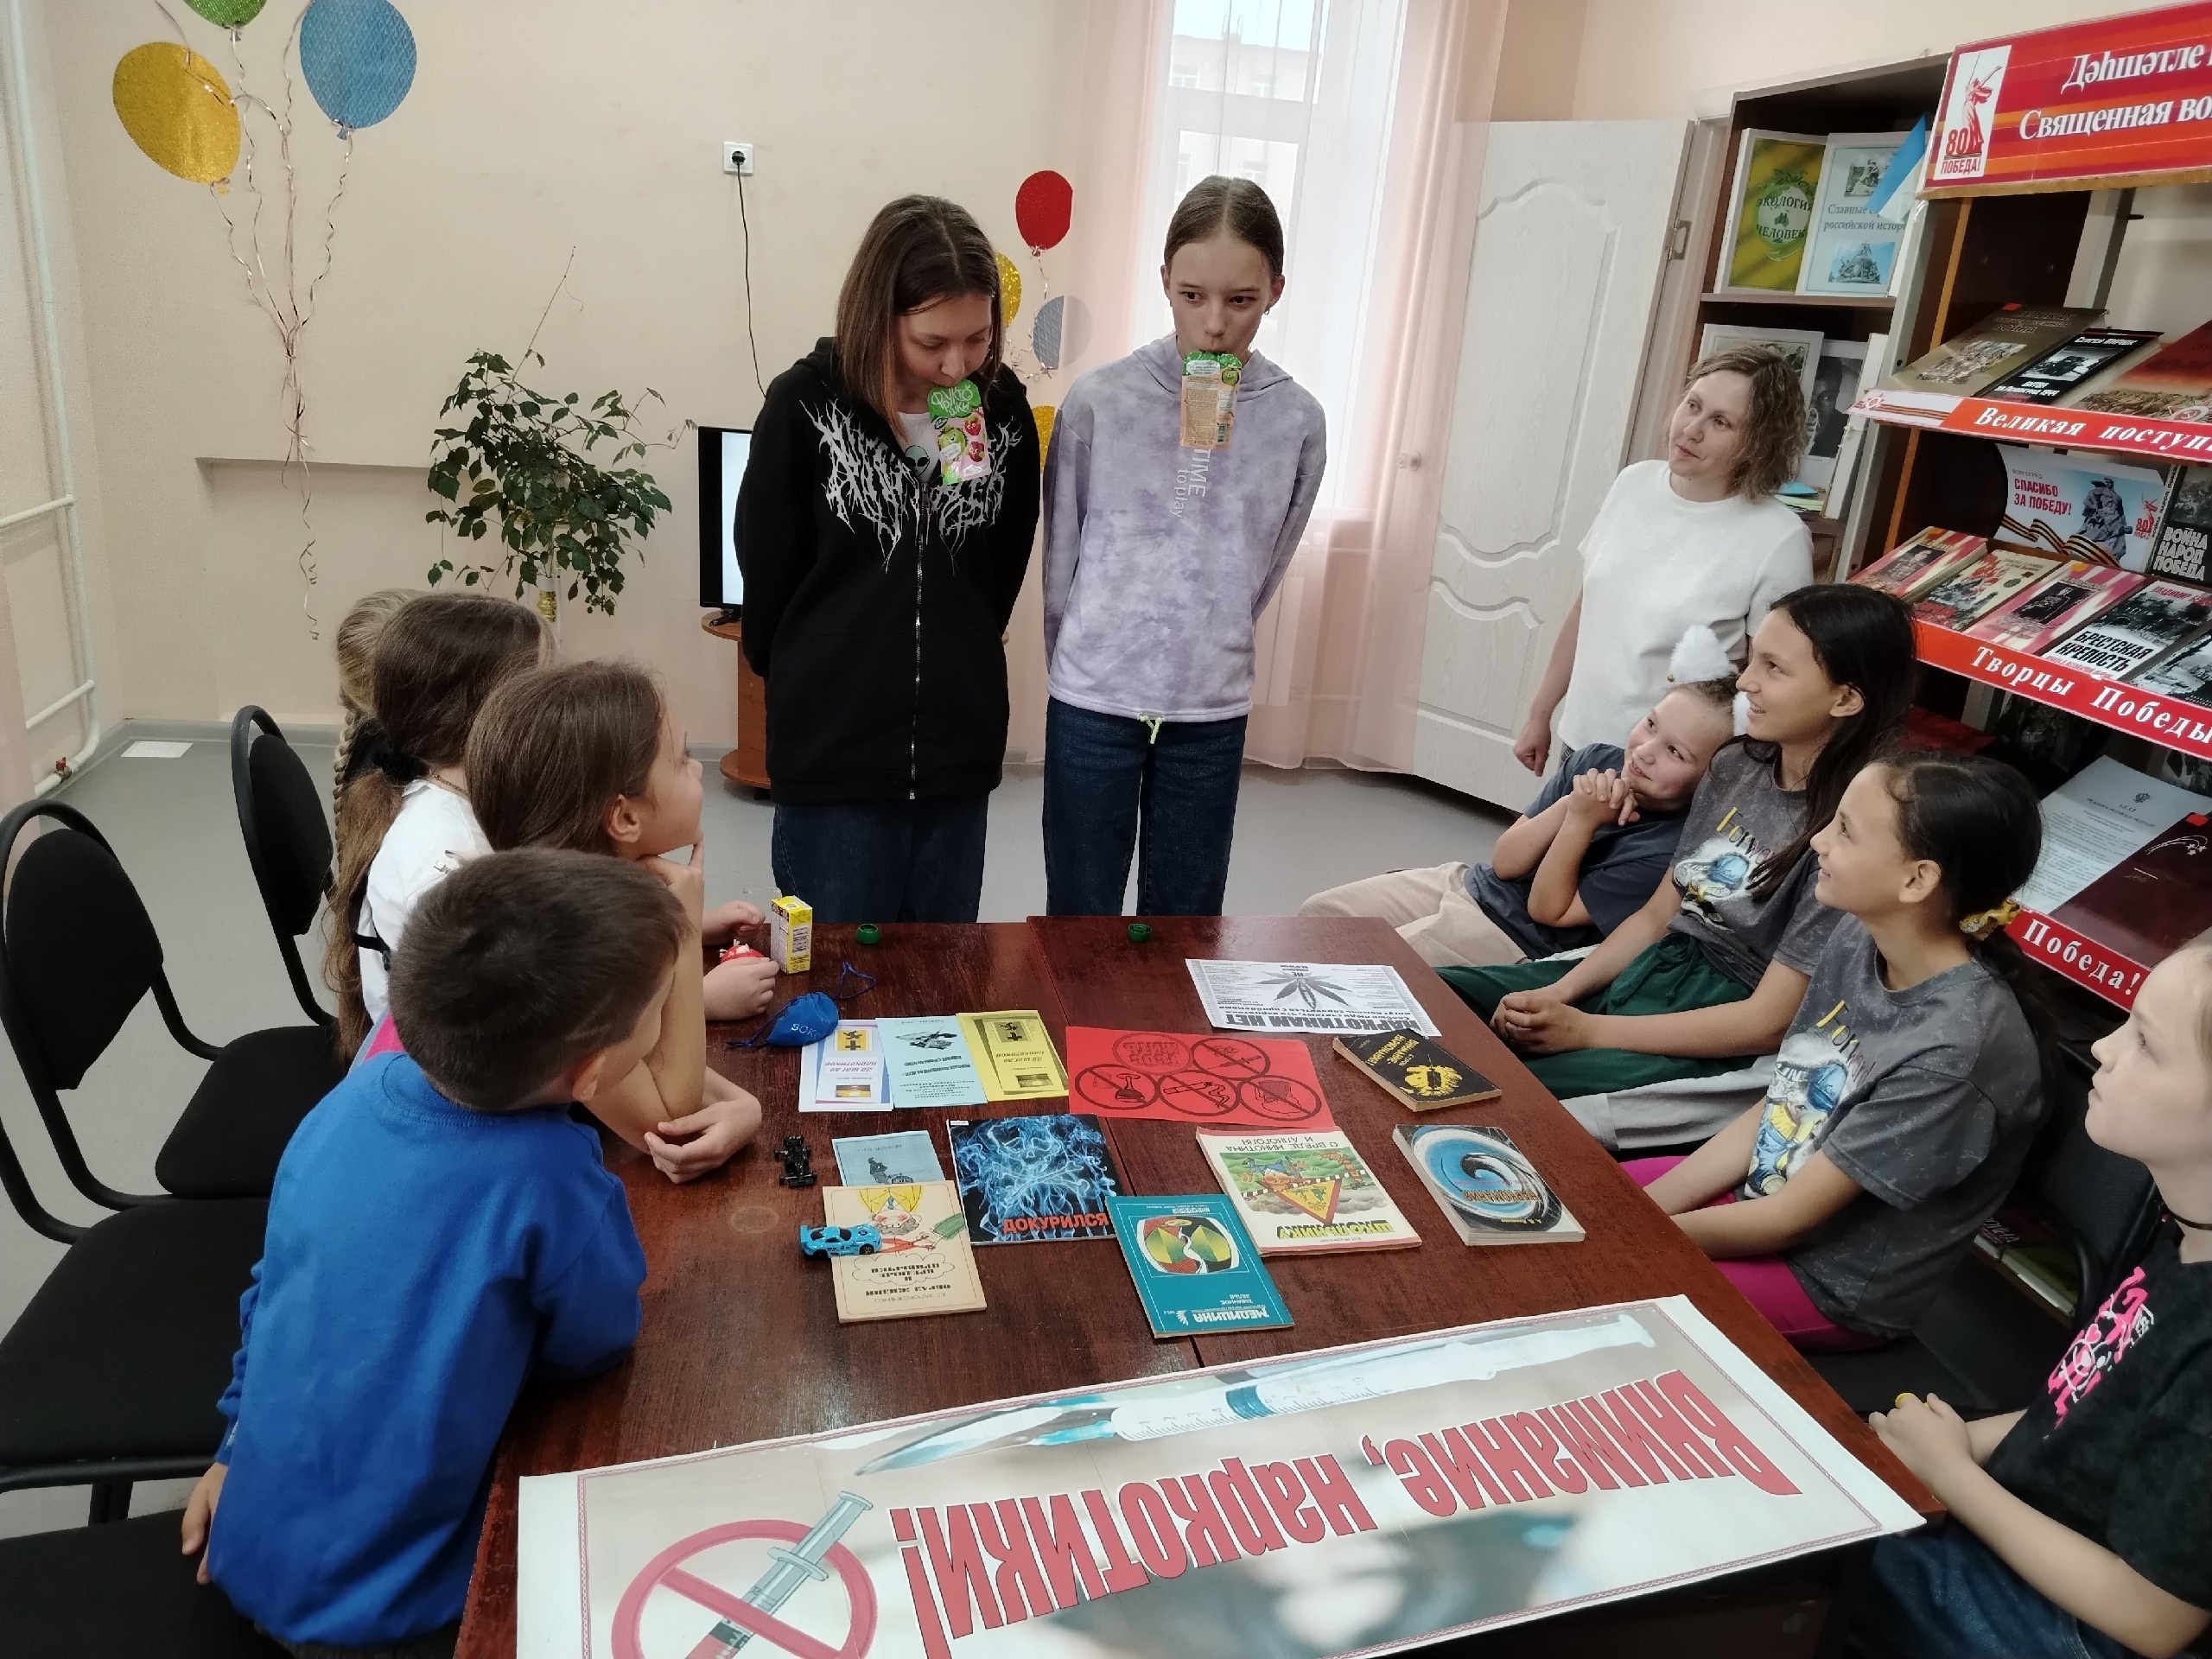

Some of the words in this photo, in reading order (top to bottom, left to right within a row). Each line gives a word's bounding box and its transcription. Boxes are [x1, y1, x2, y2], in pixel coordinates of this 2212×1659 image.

[2061, 44, 2204, 94] Дәһшәтле
[2019, 101, 2174, 140] Священная
[2177, 95, 2212, 123] во
[1946, 127, 1968, 156] 80
[1940, 158, 1980, 175] ПОБЕДА!
[1756, 197, 1813, 213] ЭКОЛОГИЯ
[1827, 204, 1867, 215] Славные
[1756, 224, 1807, 239] ЧЕЛОВЕК
[1824, 219, 1874, 235] российской
[1877, 222, 1905, 234] истор
[1974, 407, 2087, 437] Великая
[1177, 468, 1191, 484] to
[1188, 448, 1211, 498] TIME
[2014, 479, 2058, 497] СПАСИБО
[1169, 486, 1189, 518] play
[2014, 493, 2025, 506] ЗА
[2029, 495, 2072, 516] ПОБЕДУ!
[2163, 527, 2208, 550] ВОЙНА
[2158, 541, 2205, 564] НАРОД
[2153, 556, 2205, 582] ПОБЕДА
[2055, 642, 2131, 672] КРЕПОСТЬ
[2073, 631, 2154, 660] БРЕСТСКАЯ
[1970, 645, 2075, 696] Творцы
[2089, 686, 2212, 744] Победы
[2022, 918, 2141, 995] Победа!
[1226, 1014, 1266, 1027] НЕТ
[1241, 1136, 1299, 1146] АЛКОГОЛЯ
[1288, 1141, 1327, 1150] ВРЕДЕ
[1461, 1189, 1542, 1202] НАРКОМАНИЯ
[1002, 1212, 1109, 1234] ДОКУРИЛСЯ
[1277, 1220, 1395, 1240] ШКОЛЬНИКУ
[1192, 1308, 1269, 1323] МЕДИЦИНА
[1360, 1369, 1803, 1518] Внимание,
[889, 1454, 1379, 1659] наркотики!
